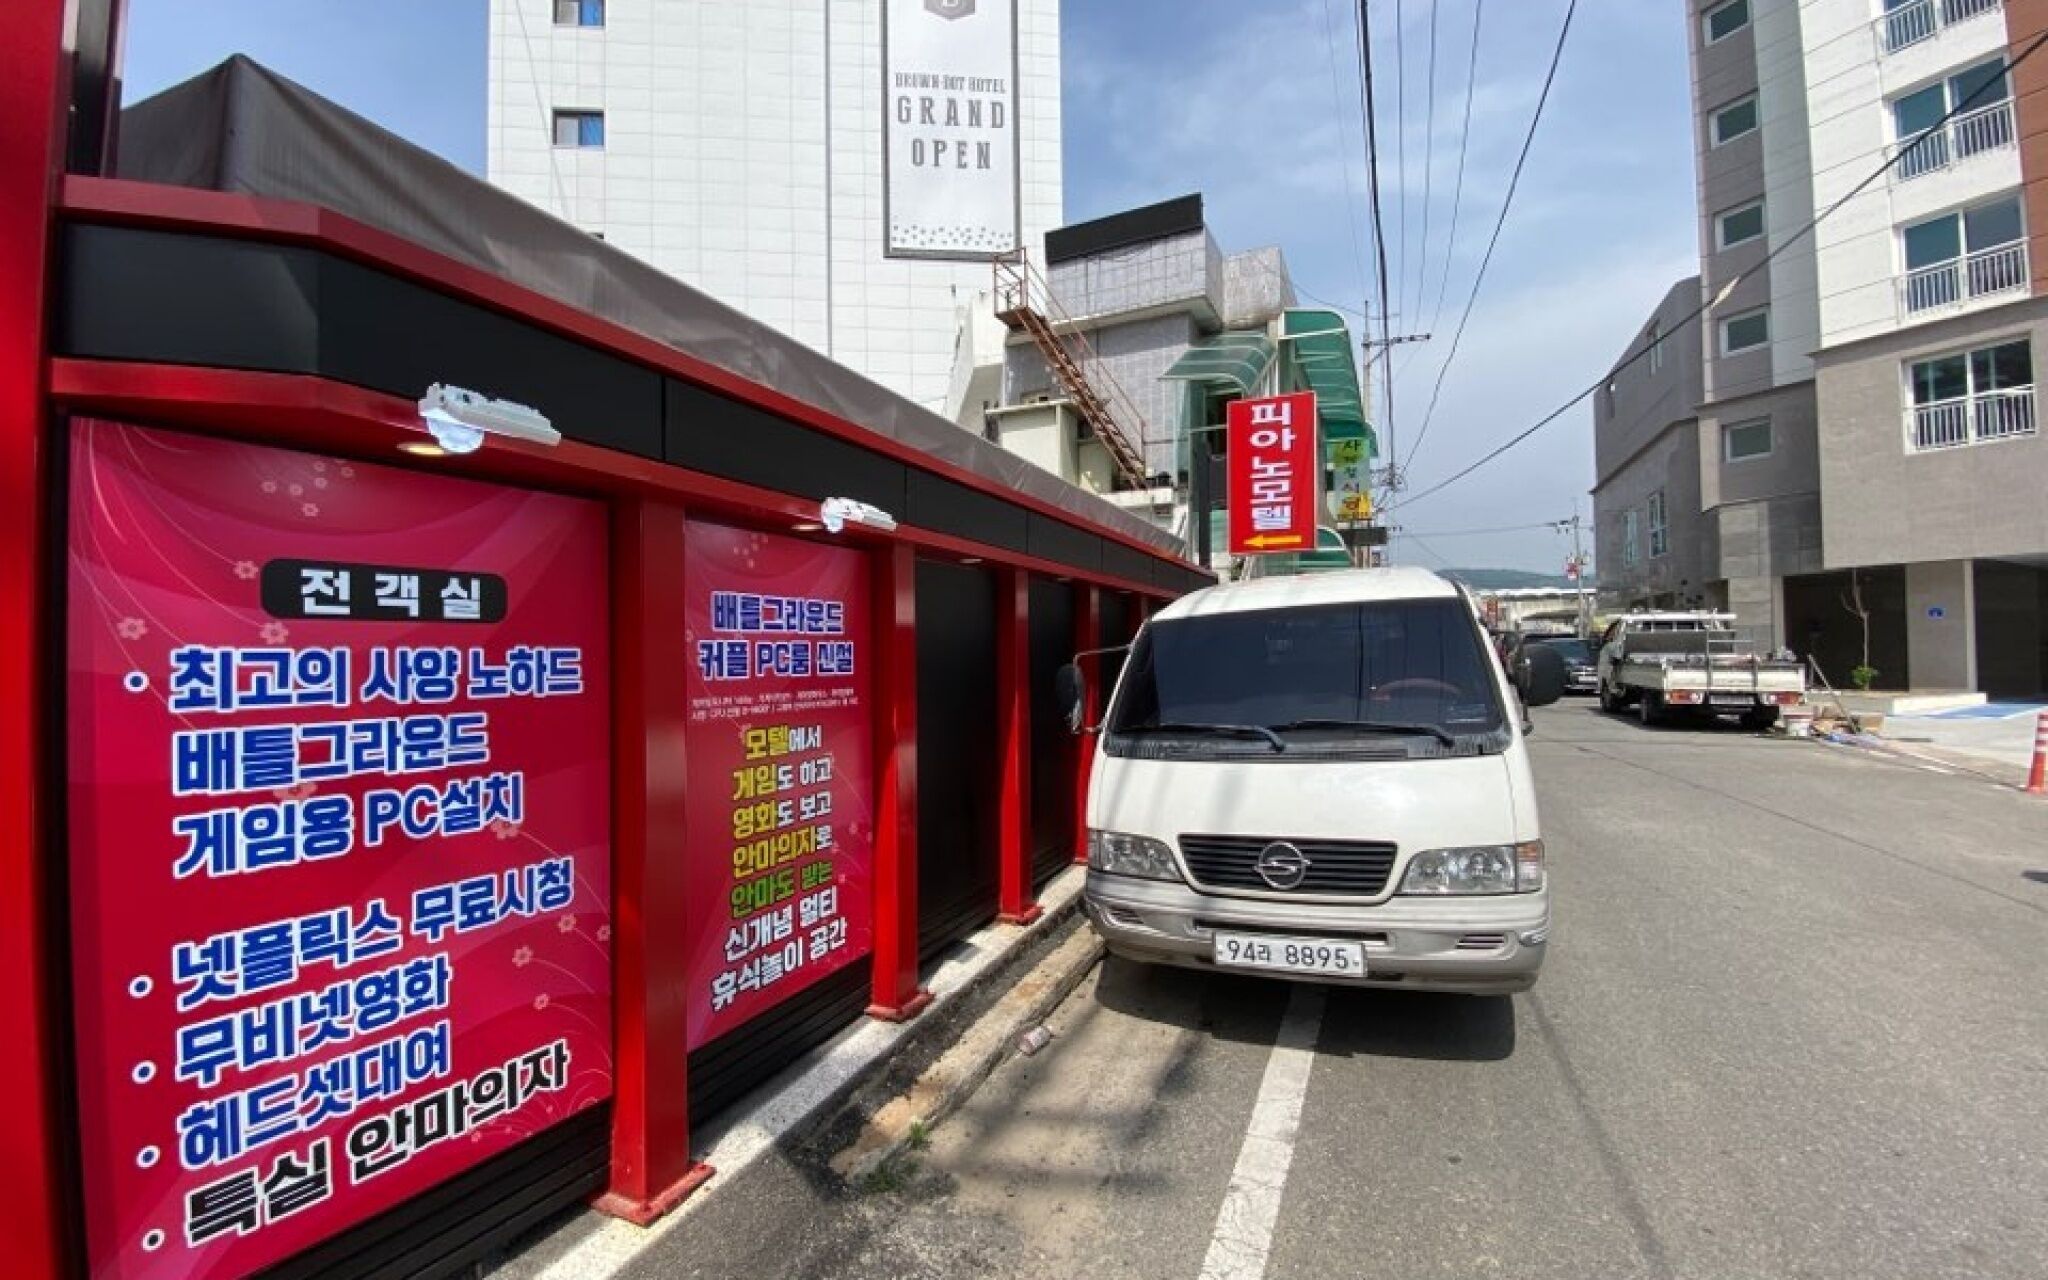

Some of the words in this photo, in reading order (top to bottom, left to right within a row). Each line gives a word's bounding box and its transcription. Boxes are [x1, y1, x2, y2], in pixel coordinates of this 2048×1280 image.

[897, 95, 1006, 129] GRAND
[912, 138, 991, 170] OPEN
[711, 590, 844, 635] 배틀그라운드
[168, 644, 349, 713] 최고의
[360, 648, 460, 703] 사양
[468, 647, 584, 699] 노하드
[697, 640, 750, 682] 커플
[755, 640, 812, 677] PC룸
[173, 713, 489, 796] 배틀그라운드
[745, 724, 822, 760] 모텔에서
[733, 764, 795, 800] 게임도
[800, 757, 832, 786] 하고
[172, 794, 354, 880] 게임용
[363, 772, 524, 847] PC설치
[733, 799, 795, 840] 영화도
[800, 790, 832, 822] 보고
[733, 824, 832, 879] 안마의자로
[731, 867, 795, 919] 안마도
[172, 899, 402, 1011] 넷플릭스
[410, 857, 574, 943] 무료시청
[724, 904, 793, 962] 신개념
[800, 885, 838, 929] 멀티
[711, 937, 803, 1011] 휴식놀이
[810, 917, 848, 961] 공간
[1285, 944, 1349, 969] 8895
[174, 953, 453, 1088] 무비넷영화
[175, 1022, 452, 1170] 헤드셋대여
[184, 1137, 333, 1247] 특실
[345, 1040, 570, 1185] 안마의자
